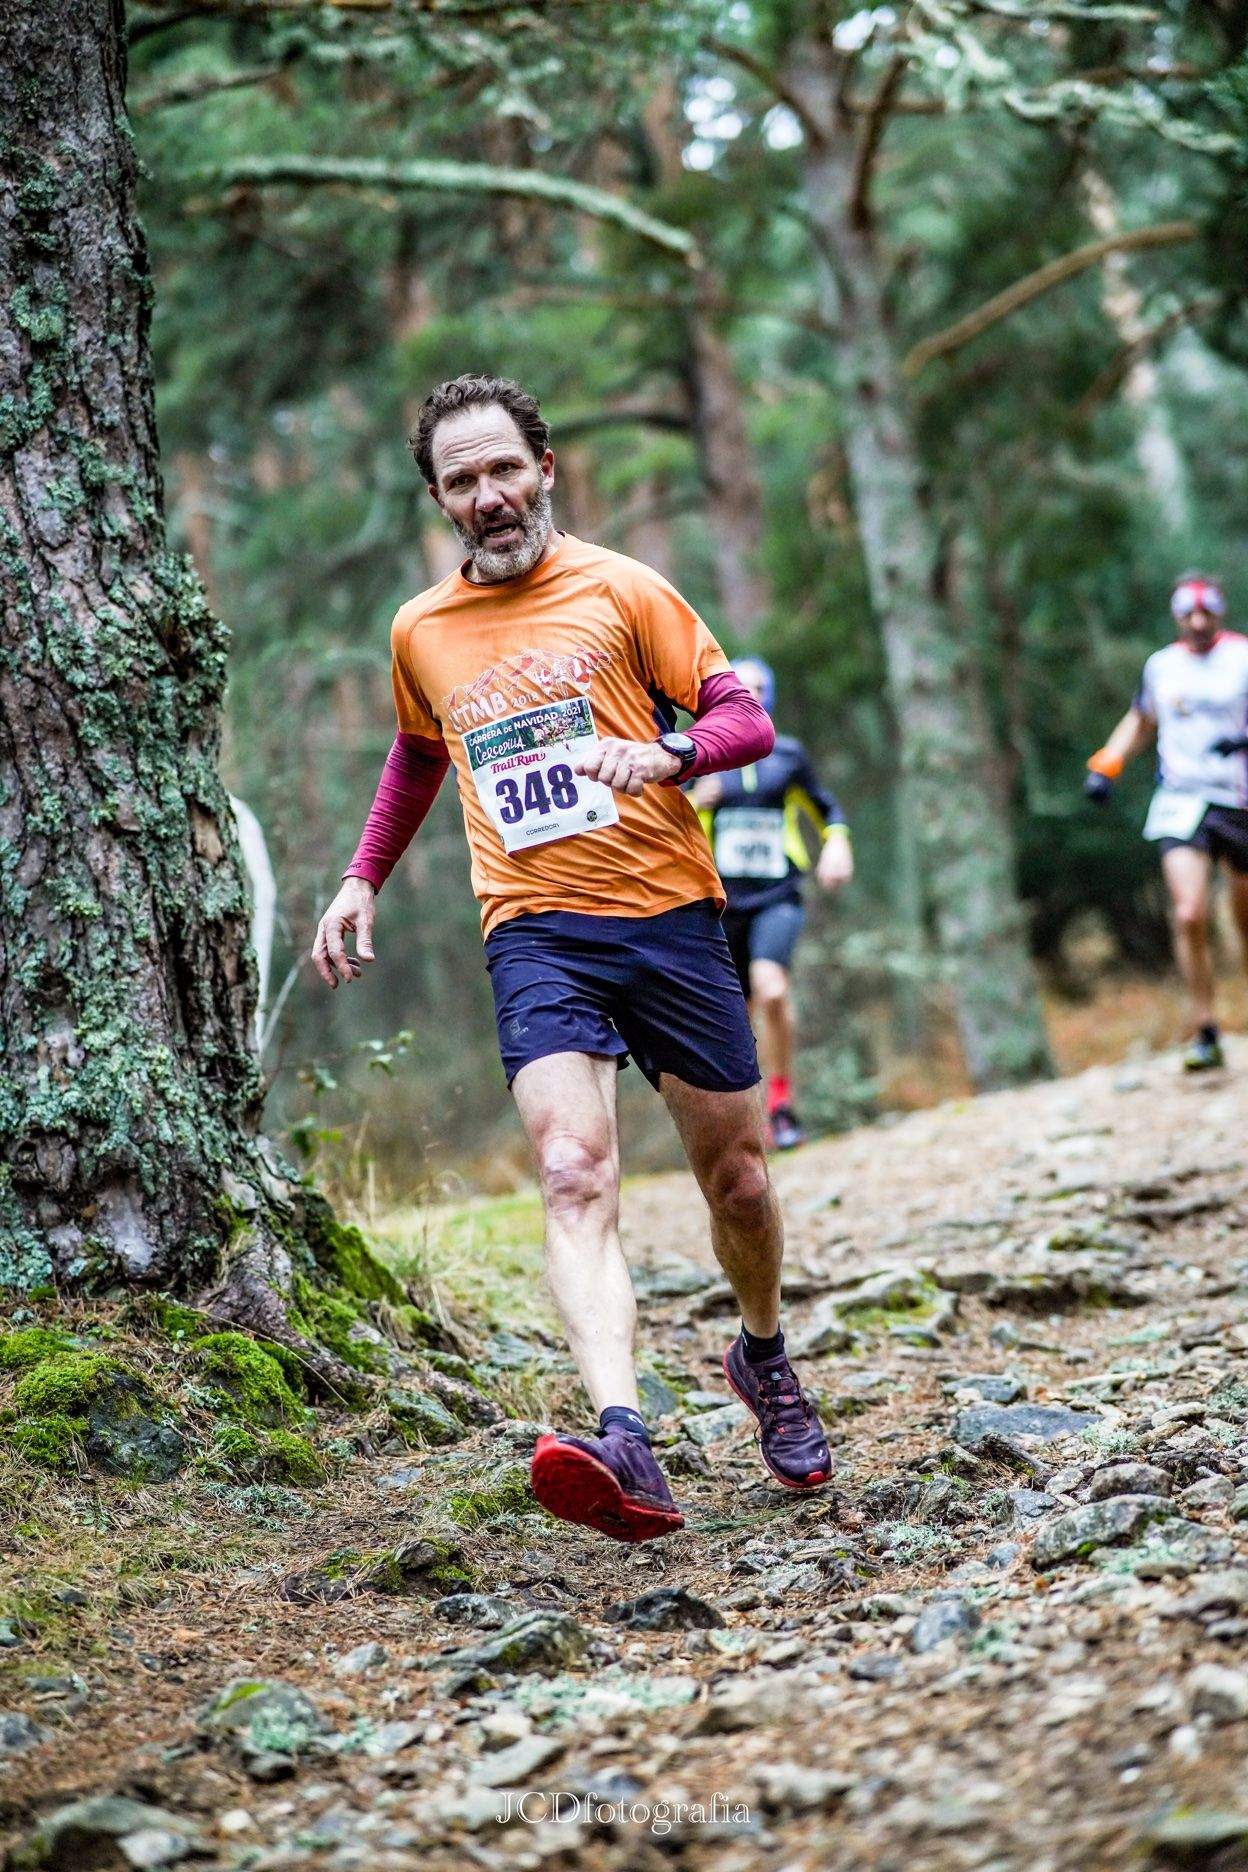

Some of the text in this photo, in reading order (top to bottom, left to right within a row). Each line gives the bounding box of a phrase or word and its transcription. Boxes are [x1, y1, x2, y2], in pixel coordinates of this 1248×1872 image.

[448, 691, 508, 732] UTMB
[469, 706, 581, 746] CARRERA DE NAVIDAD 2021
[495, 763, 579, 825] 348
